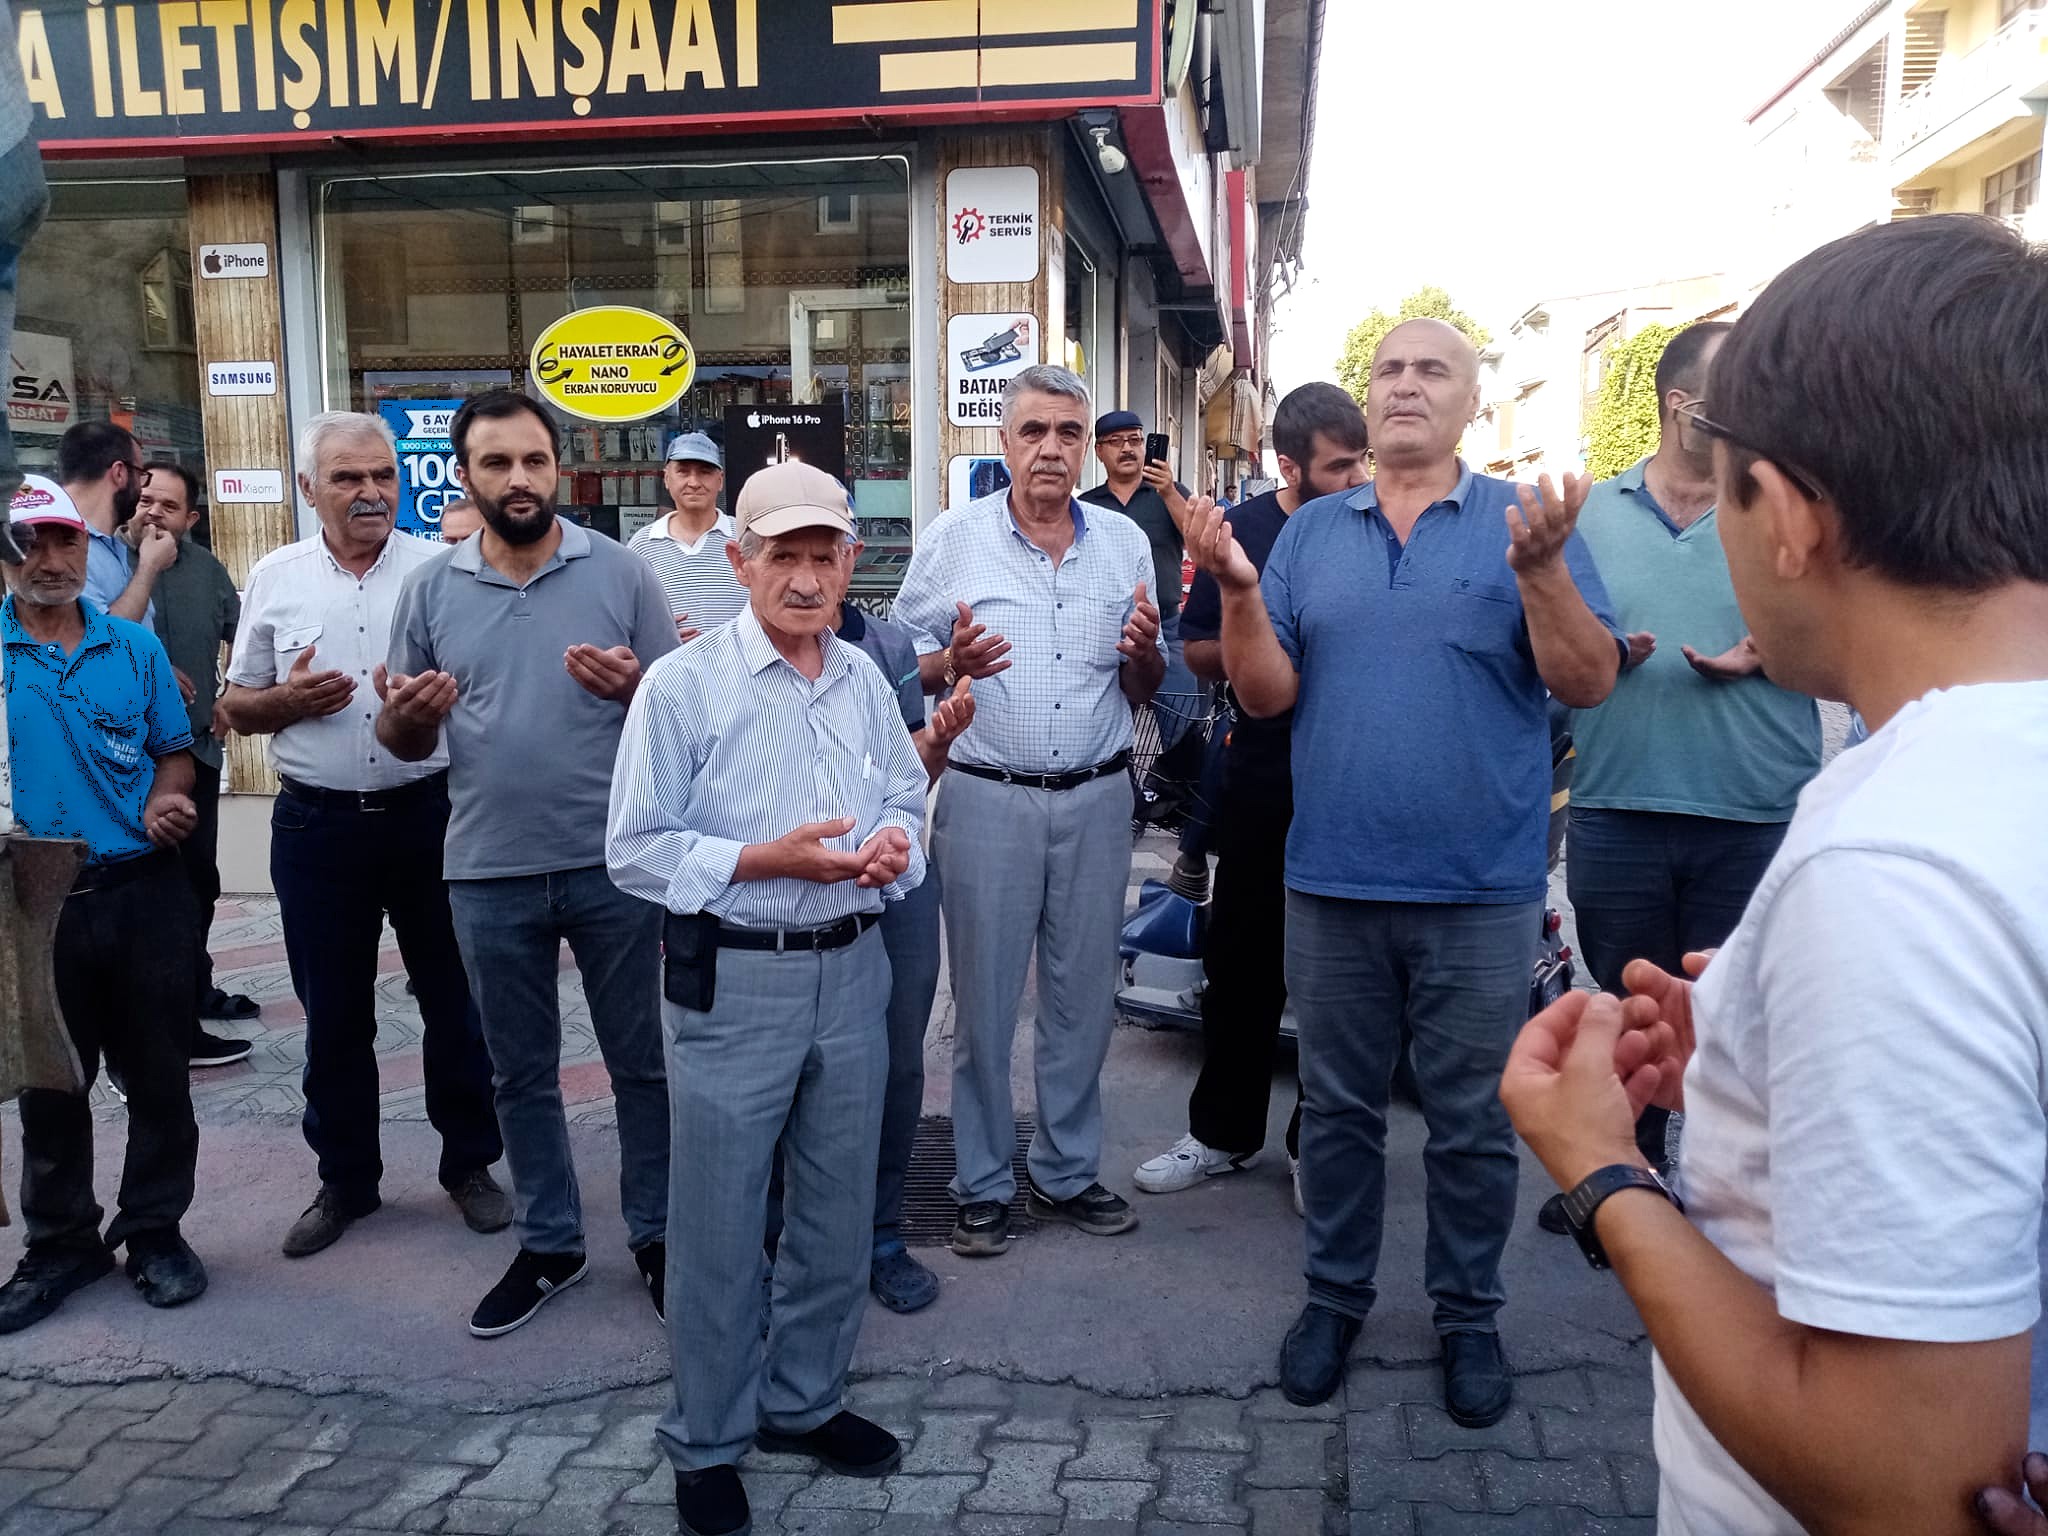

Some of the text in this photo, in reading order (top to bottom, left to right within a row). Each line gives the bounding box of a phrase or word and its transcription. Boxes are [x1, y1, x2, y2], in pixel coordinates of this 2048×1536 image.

[988, 212, 1033, 224] TEKNİK
[989, 225, 1032, 237] SERVİS
[223, 254, 265, 268] iPhone
[559, 344, 659, 359] HAYALET EKRAN
[212, 372, 272, 385] SAMSUNG
[591, 366, 629, 379] NANO
[564, 383, 657, 395] EKRAN KORUYUCU
[959, 379, 1011, 394] BATAR
[423, 415, 449, 426] 6 AY
[761, 414, 821, 425] iPhone 16 Pro
[243, 484, 277, 495] Xiaomi
